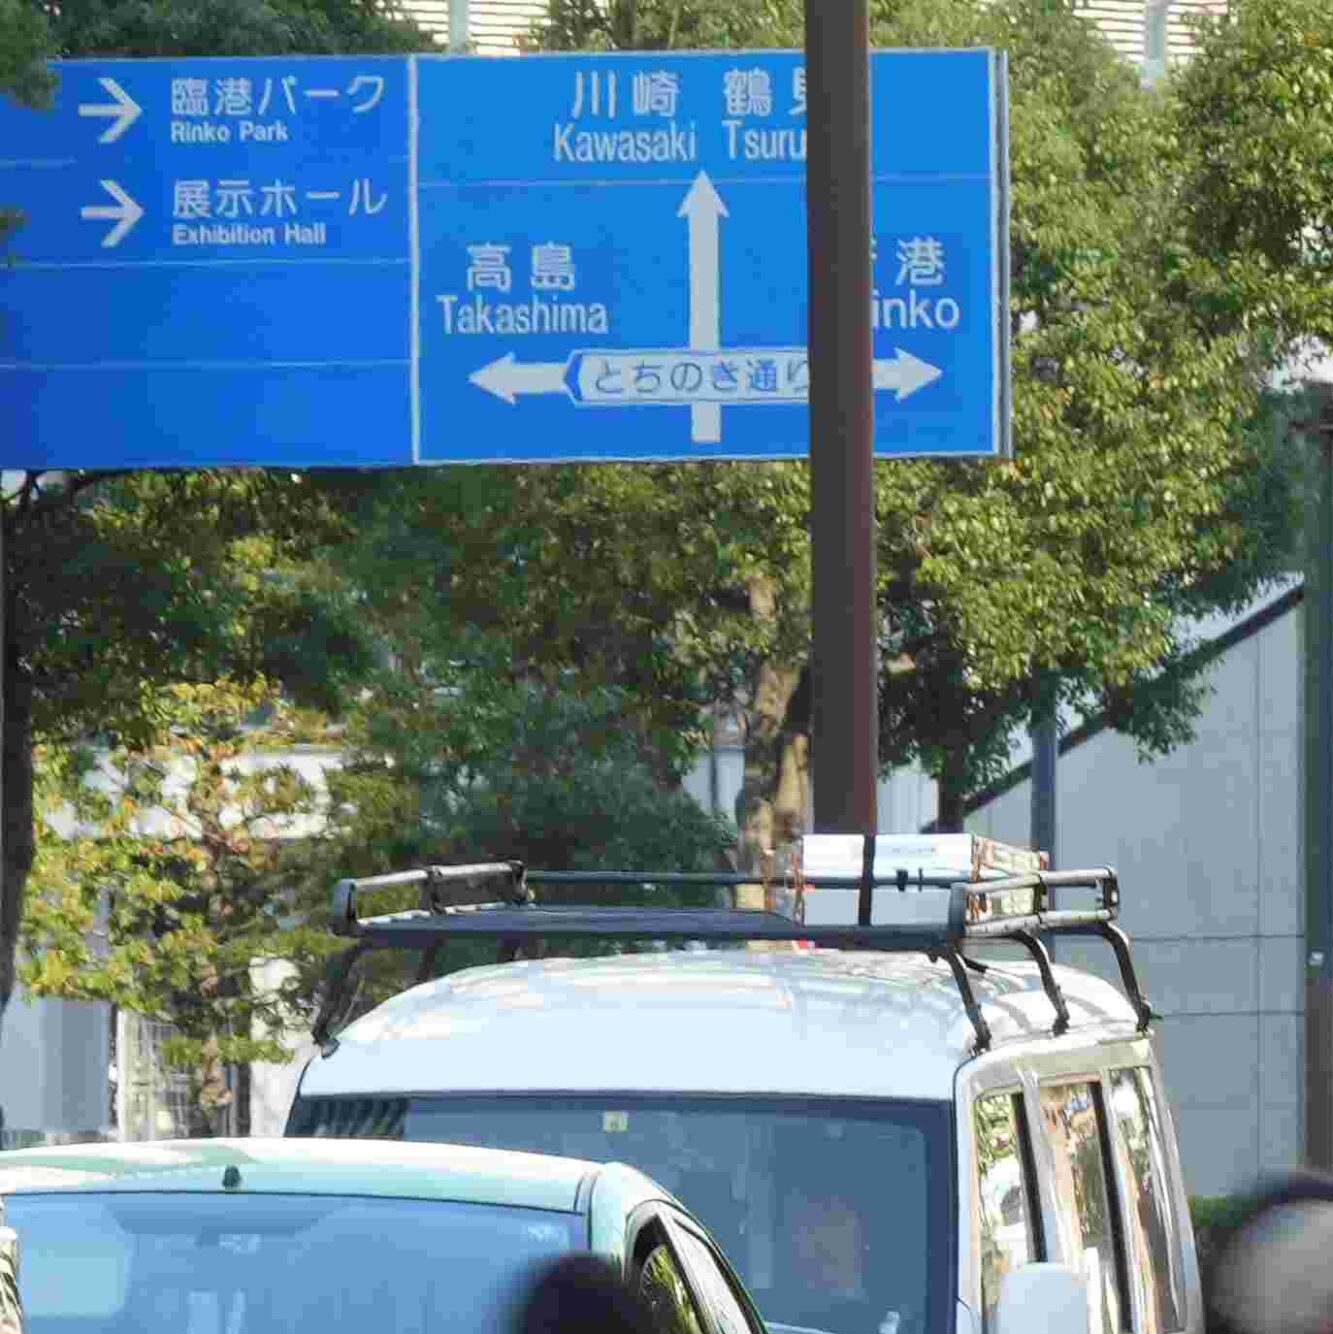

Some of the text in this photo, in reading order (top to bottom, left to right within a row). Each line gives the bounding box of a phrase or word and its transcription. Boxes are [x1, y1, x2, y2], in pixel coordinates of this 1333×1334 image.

[171, 75, 385, 117] 臨港パーク
[572, 70, 679, 119] 川崎
[171, 121, 289, 143] Rinko Park
[553, 119, 808, 162] Kawasaki Tsuru
[173, 178, 388, 219] 展示ホール
[172, 223, 327, 246] Exhibition Hall
[466, 241, 577, 293] 高島
[435, 294, 609, 334] Takashima
[871, 288, 961, 329] inko
